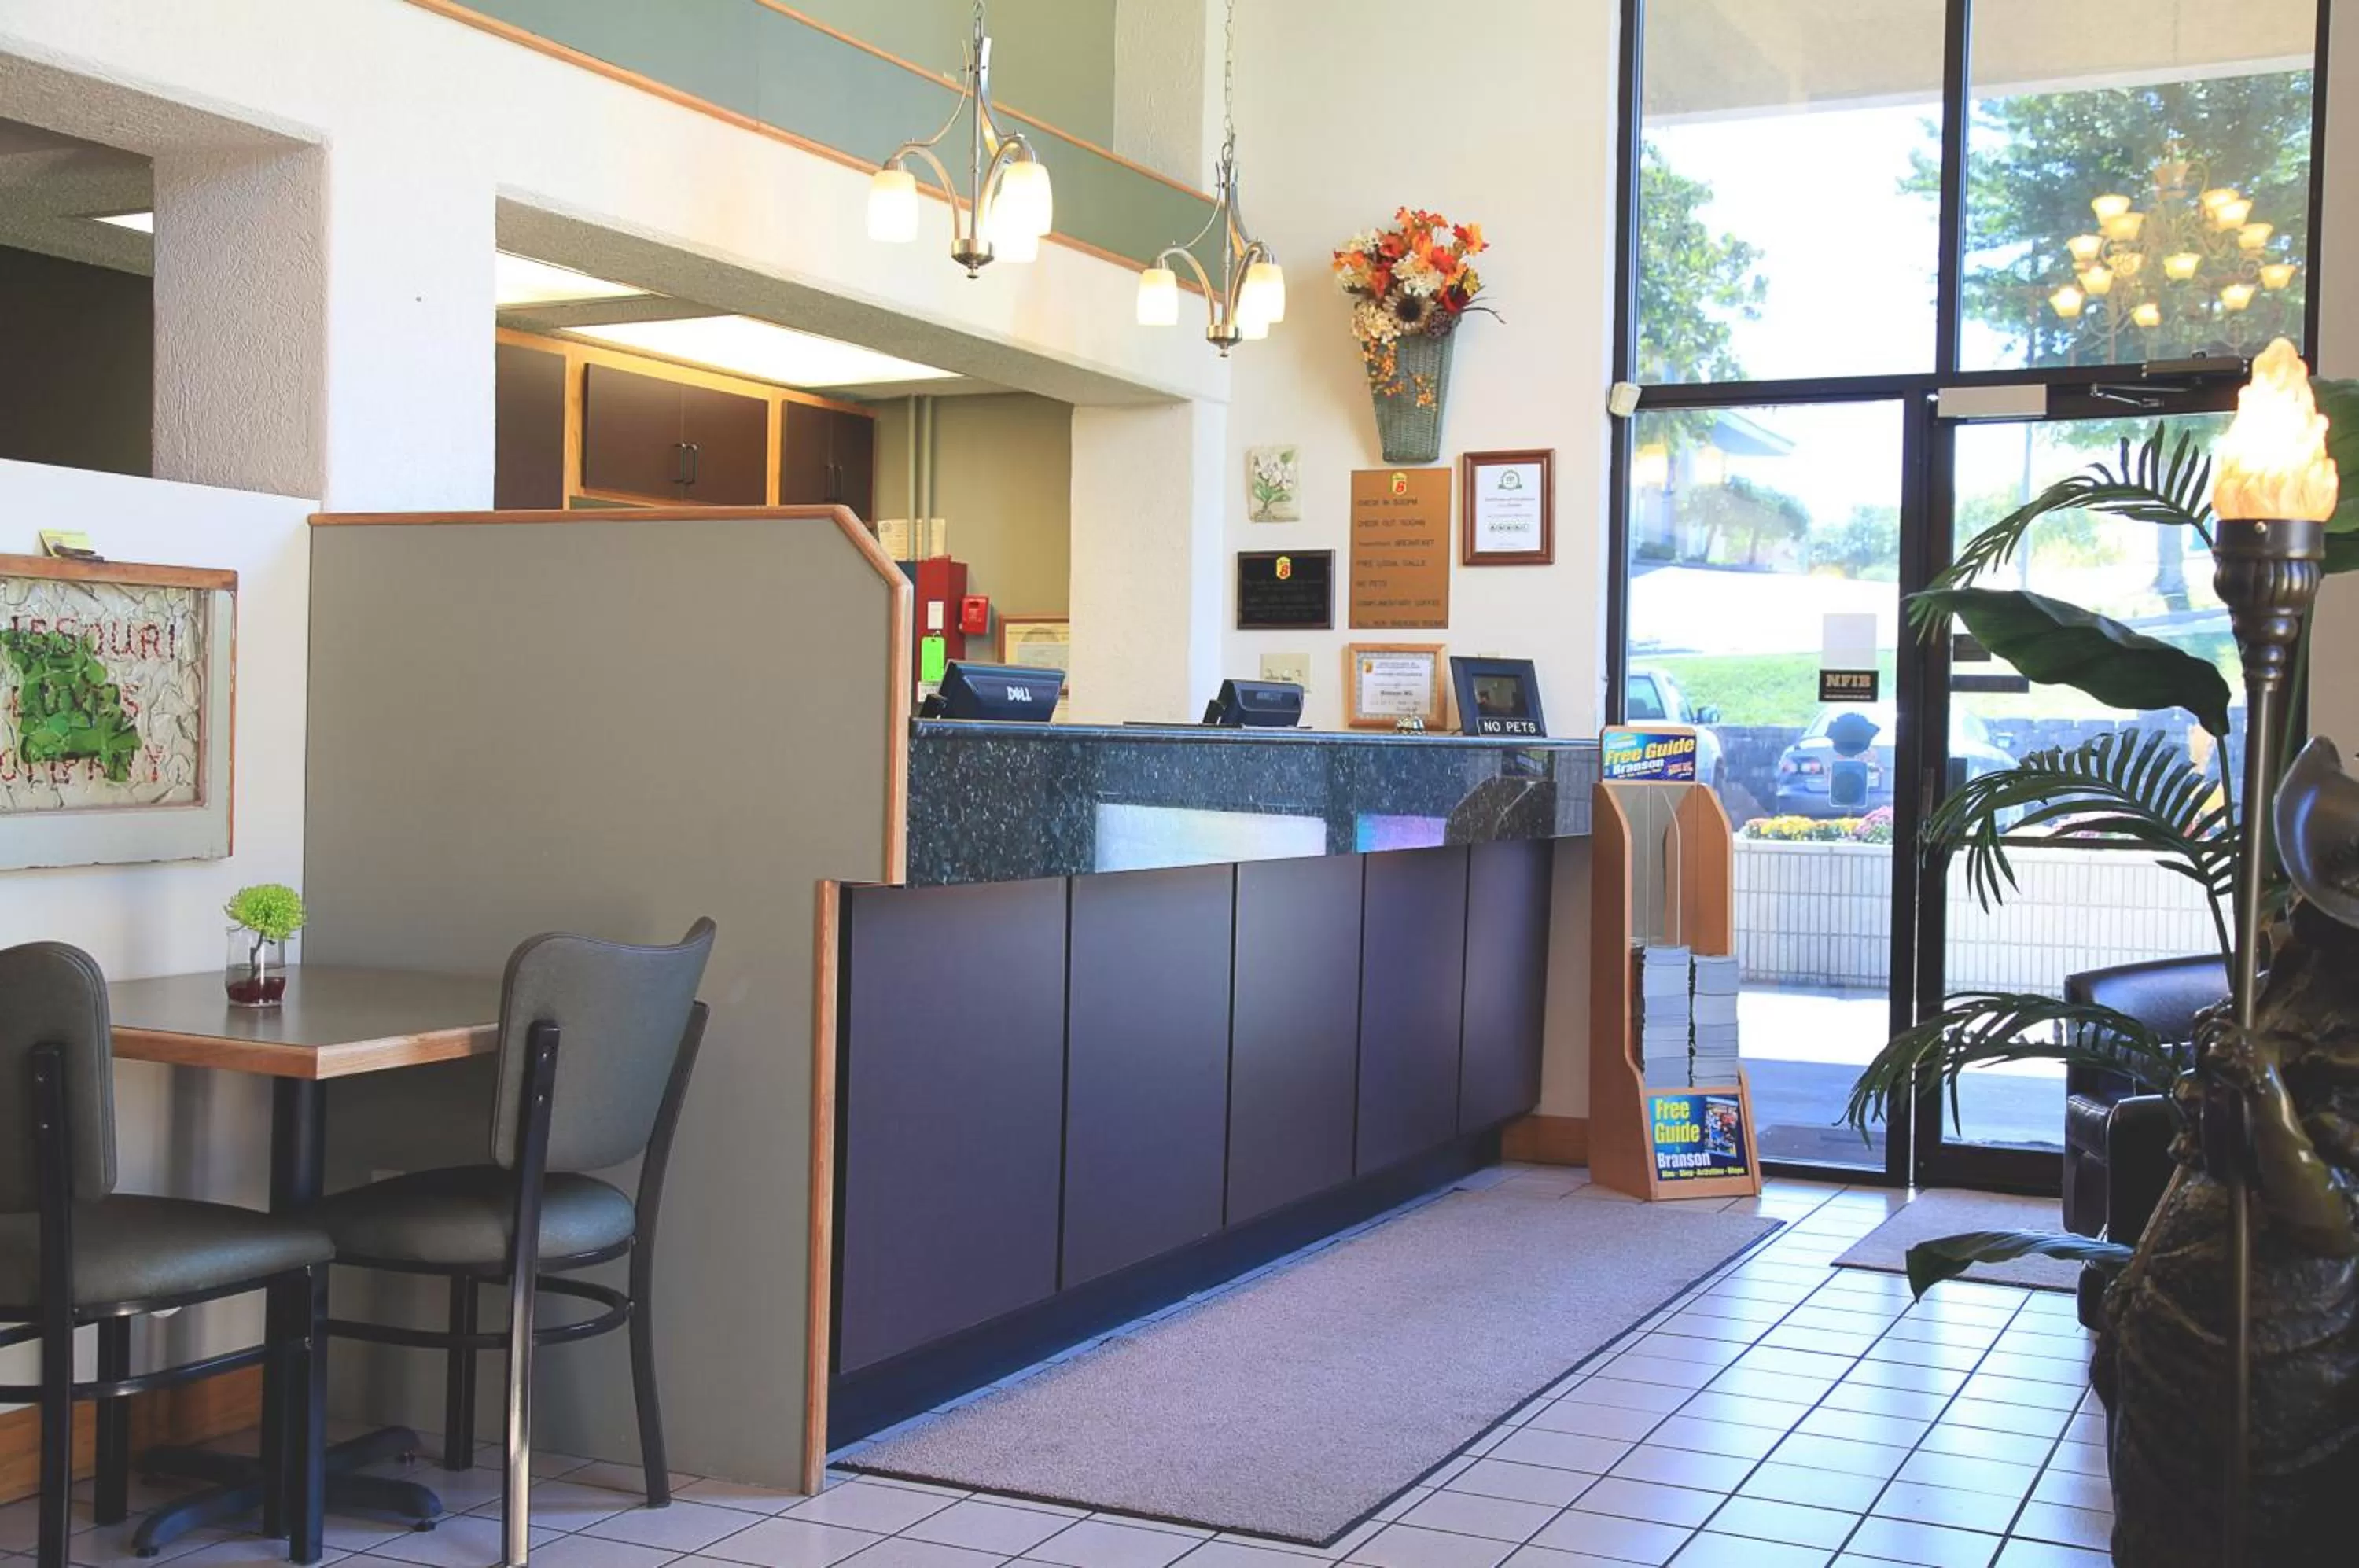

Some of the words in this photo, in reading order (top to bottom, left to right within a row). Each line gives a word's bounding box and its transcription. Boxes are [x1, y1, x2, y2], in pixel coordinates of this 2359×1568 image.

[1825, 673, 1871, 687] NFIB
[1006, 686, 1032, 702] DELL
[1484, 720, 1501, 732] NO
[1506, 721, 1536, 734] PETS
[1605, 747, 1643, 766] Free
[1644, 738, 1695, 760] Guide
[1613, 758, 1665, 775] Branson
[1655, 1099, 1690, 1120] Free
[1654, 1121, 1701, 1143] Guide
[1657, 1152, 1711, 1169] Branson
